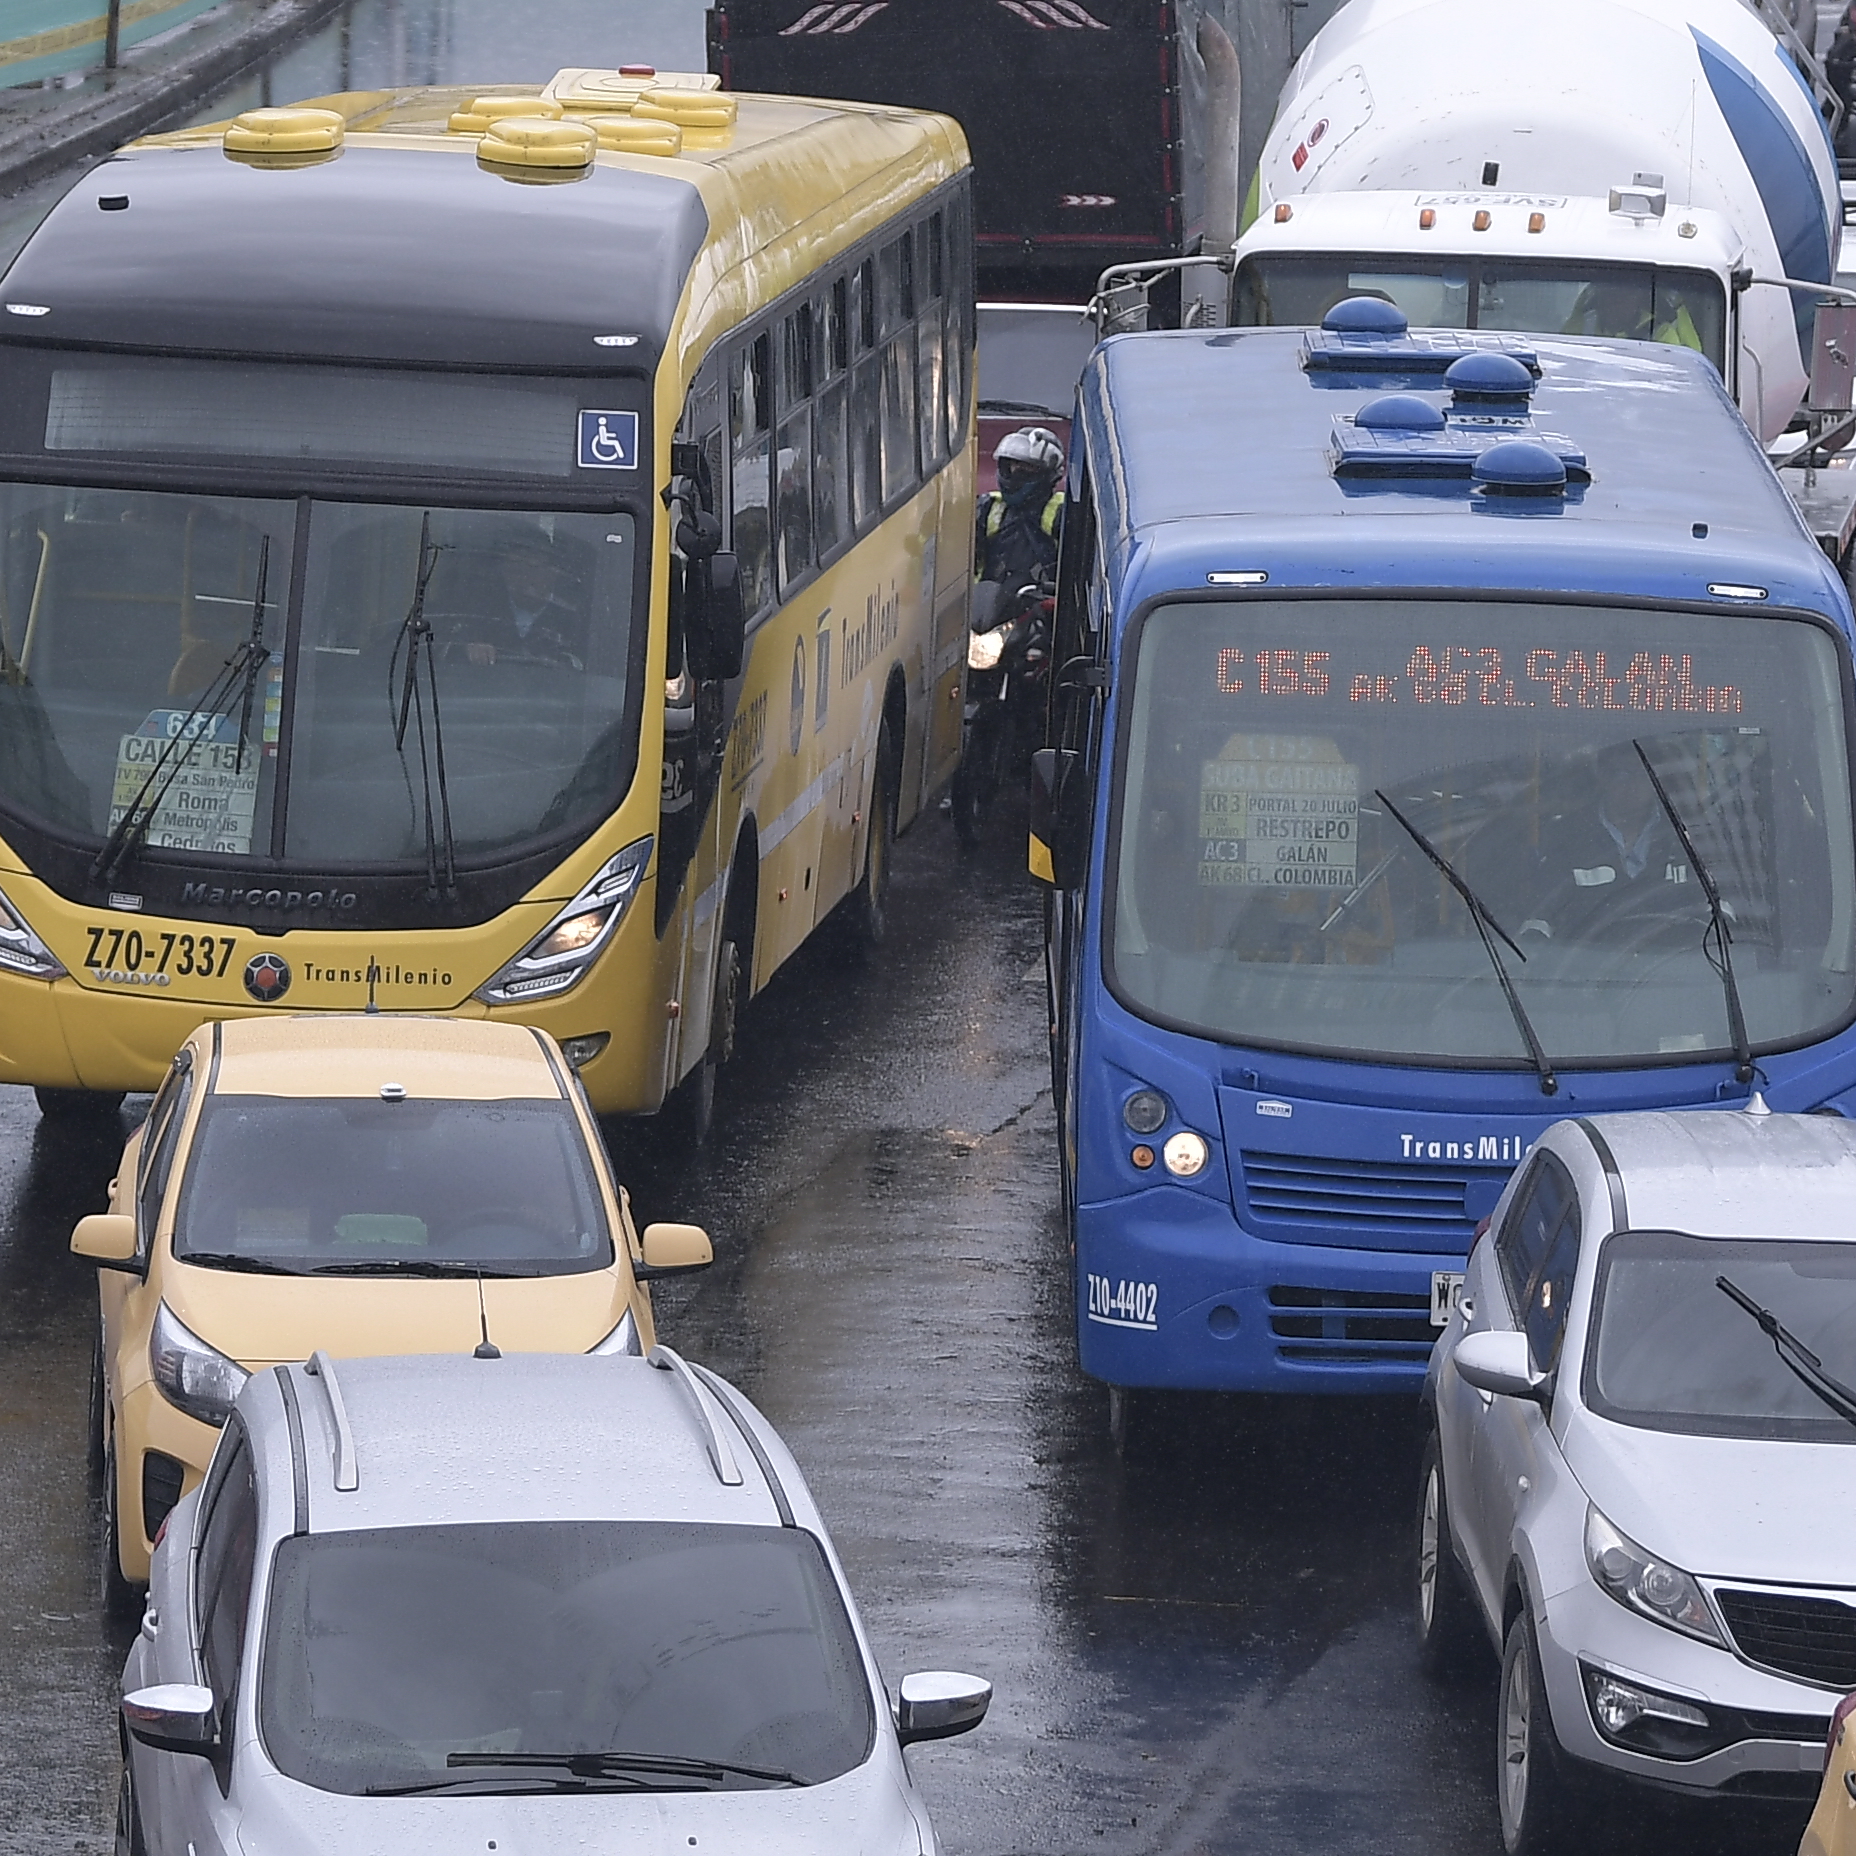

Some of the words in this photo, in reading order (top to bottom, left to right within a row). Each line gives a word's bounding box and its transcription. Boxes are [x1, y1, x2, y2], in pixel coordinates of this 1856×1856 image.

[1348, 674, 1398, 703] AK
[125, 737, 202, 767] CALLE
[192, 773, 215, 787] San
[1202, 764, 1259, 788] SUBA
[178, 791, 230, 812] Roma
[1249, 798, 1298, 812] PORTAL
[1302, 799, 1317, 813] 20
[1320, 799, 1357, 814] JULIO
[1256, 819, 1350, 840] RESTREPO
[1276, 843, 1328, 863] GALÁN
[1199, 866, 1221, 883] AK
[1223, 866, 1243, 883] 68
[1274, 868, 1355, 886] COLOMBIA
[182, 881, 358, 910] Marcopolo
[84, 926, 237, 978] Z70-7337
[93, 968, 172, 987] VOLVO
[303, 961, 453, 987] TransMilenio
[1087, 1273, 1159, 1324] Z10-4402
